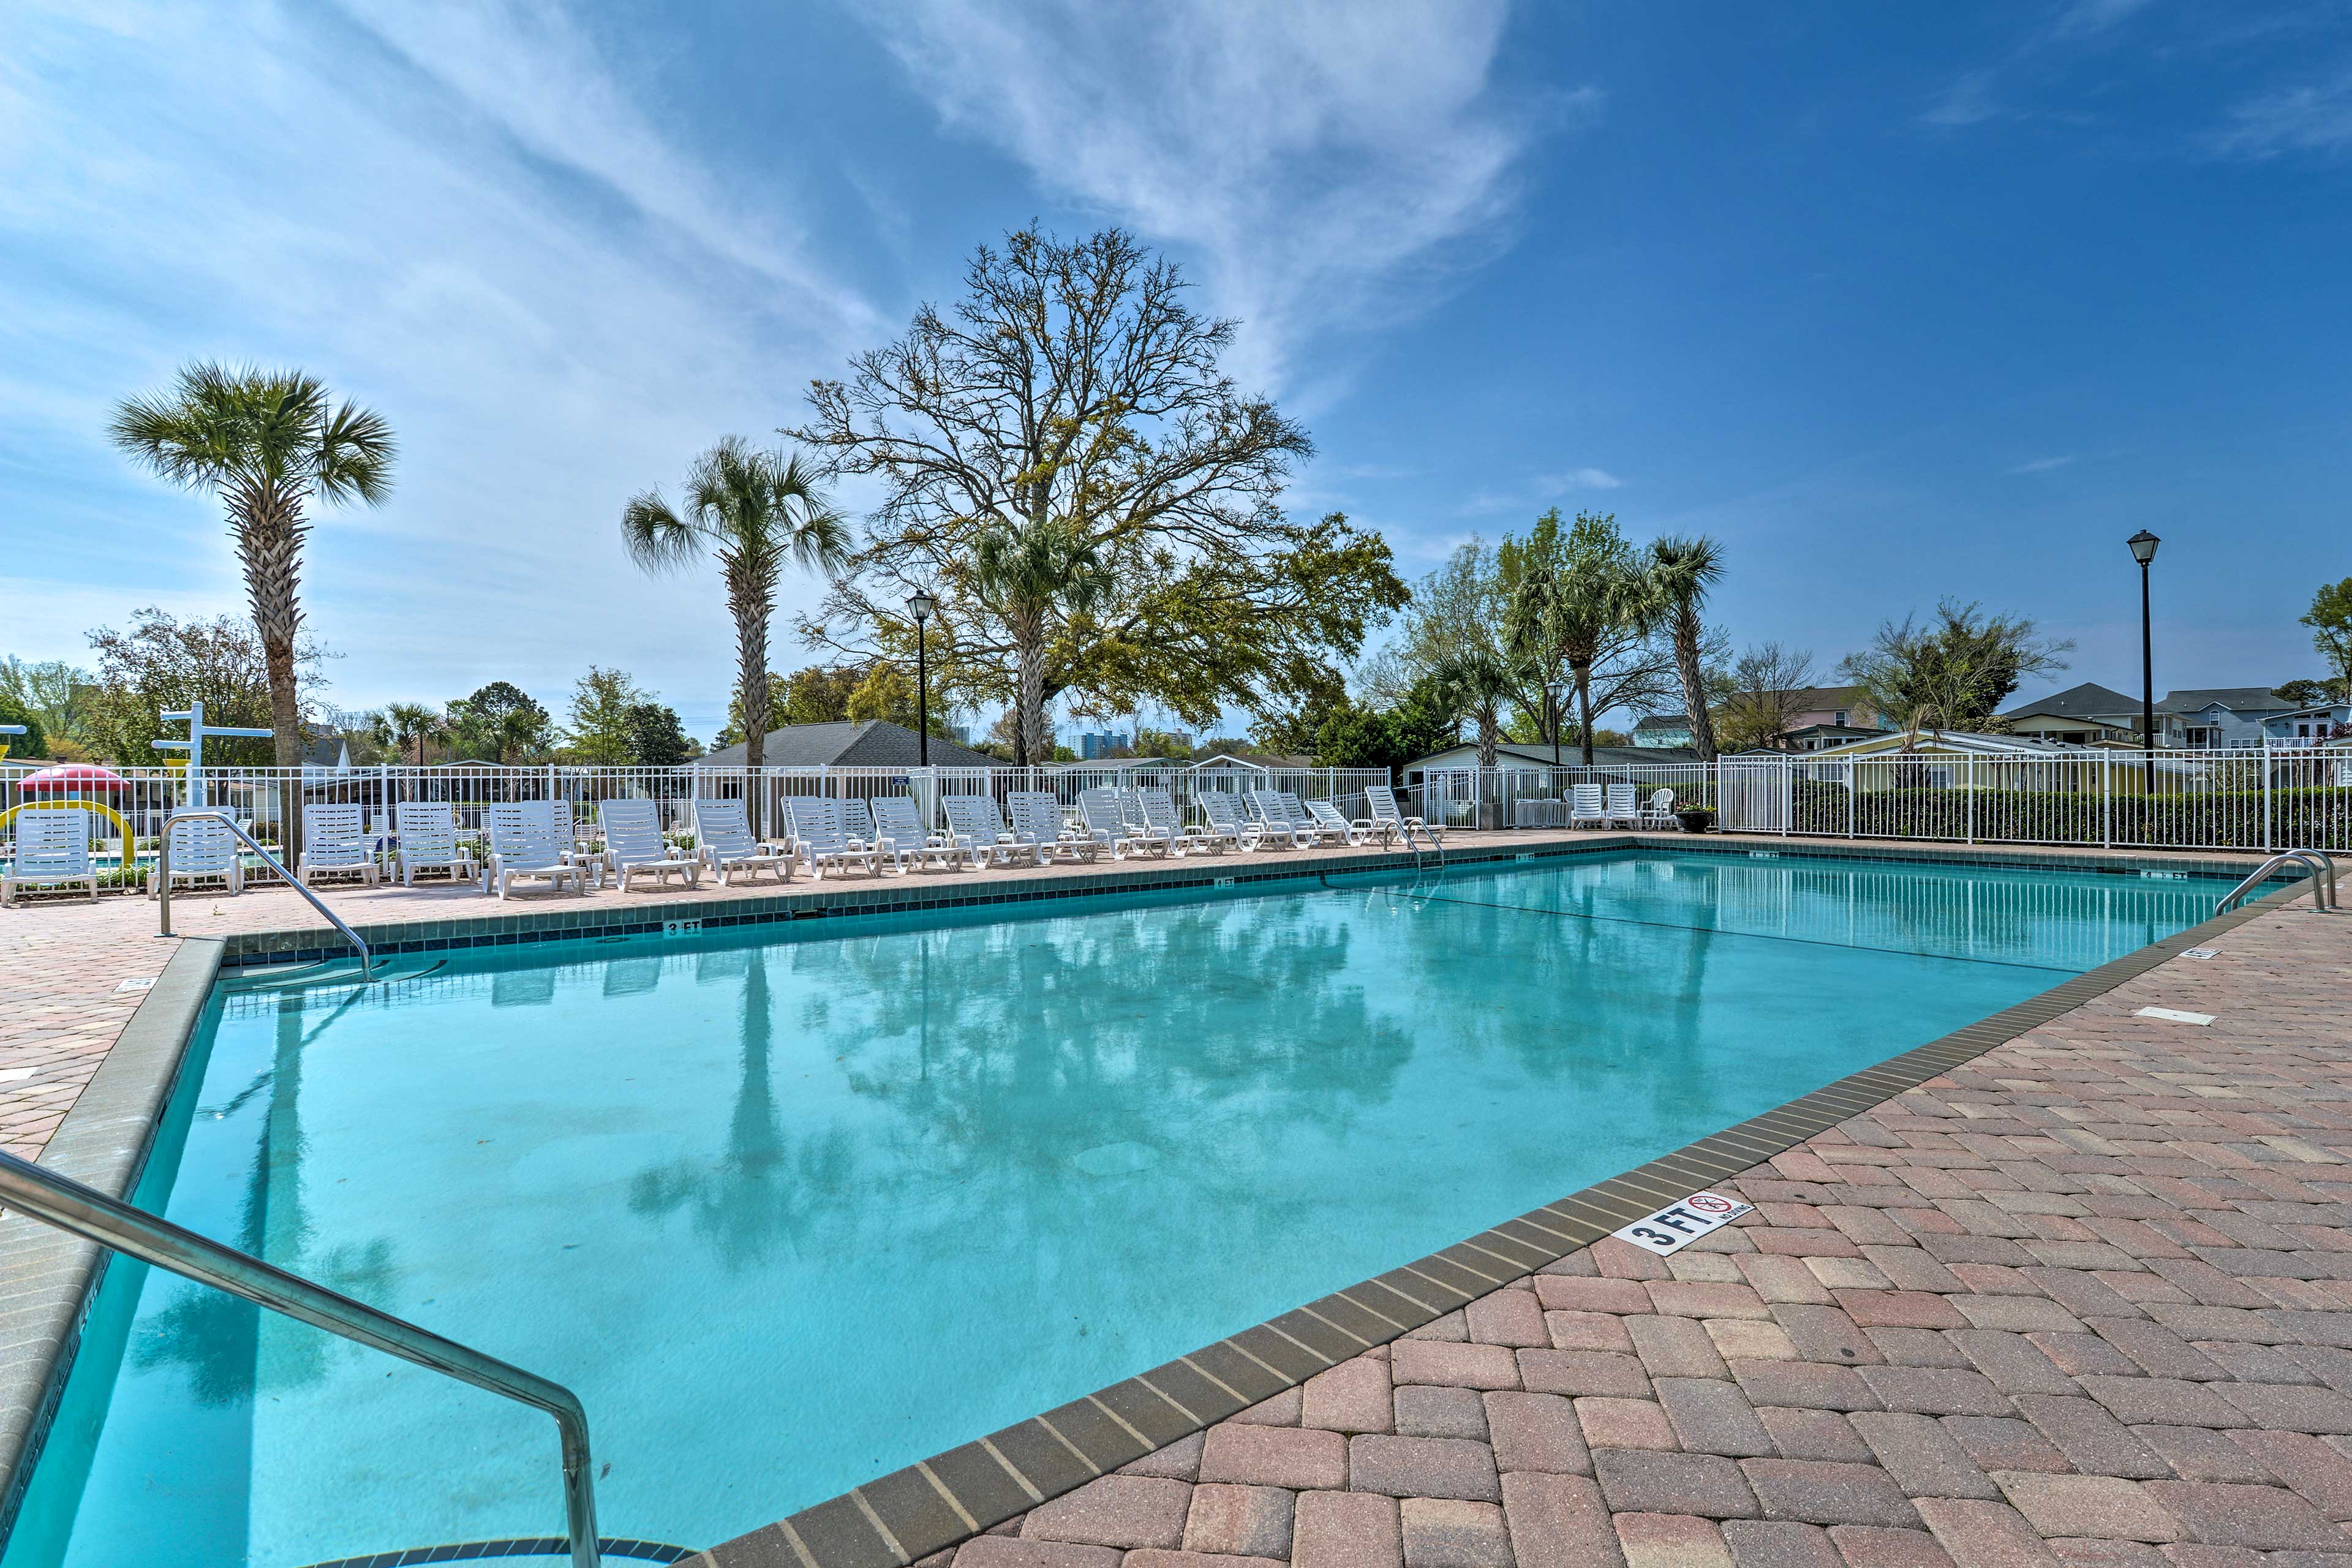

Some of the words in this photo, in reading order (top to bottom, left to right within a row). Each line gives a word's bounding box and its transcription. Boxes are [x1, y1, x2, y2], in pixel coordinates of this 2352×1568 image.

[684, 921, 700, 930] FT
[1727, 1204, 1751, 1216] DIVING
[1653, 1207, 1713, 1234] FT
[1631, 1227, 1676, 1246] 3
